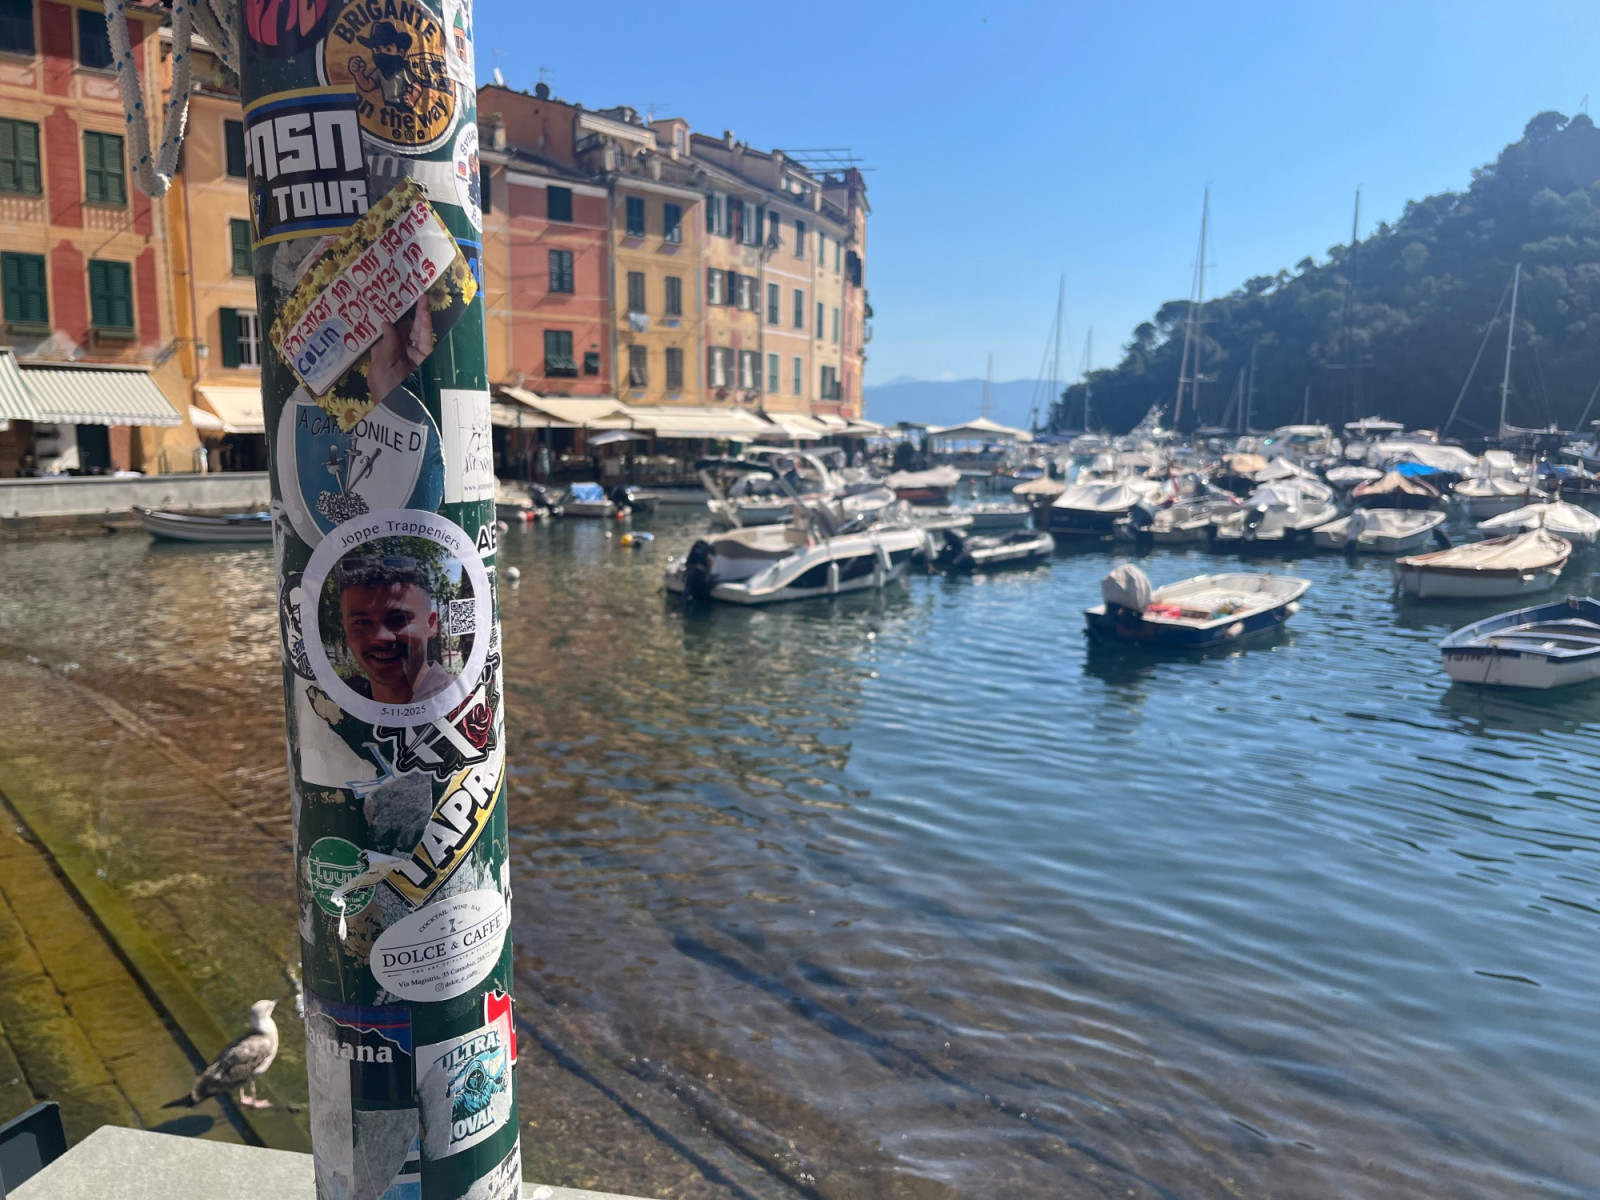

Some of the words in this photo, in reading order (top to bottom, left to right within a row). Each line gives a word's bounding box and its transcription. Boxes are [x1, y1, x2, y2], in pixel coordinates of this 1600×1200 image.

[333, 0, 437, 44] BRIGANTE
[381, 107, 415, 129] the
[417, 96, 449, 128] way
[272, 180, 369, 222] TOUR
[300, 408, 308, 429] A
[311, 417, 404, 453] CAONILE
[409, 431, 421, 452] D
[340, 525, 380, 548] Joppe
[386, 520, 461, 551] Trappeniers
[381, 705, 427, 717] 5-11-2025
[418, 909, 449, 933] COCKTAIL
[452, 903, 468, 912] WINE
[382, 942, 447, 968] DOLCE
[450, 941, 459, 950] &
[398, 980, 410, 988] Via
[443, 971, 450, 979] 35
